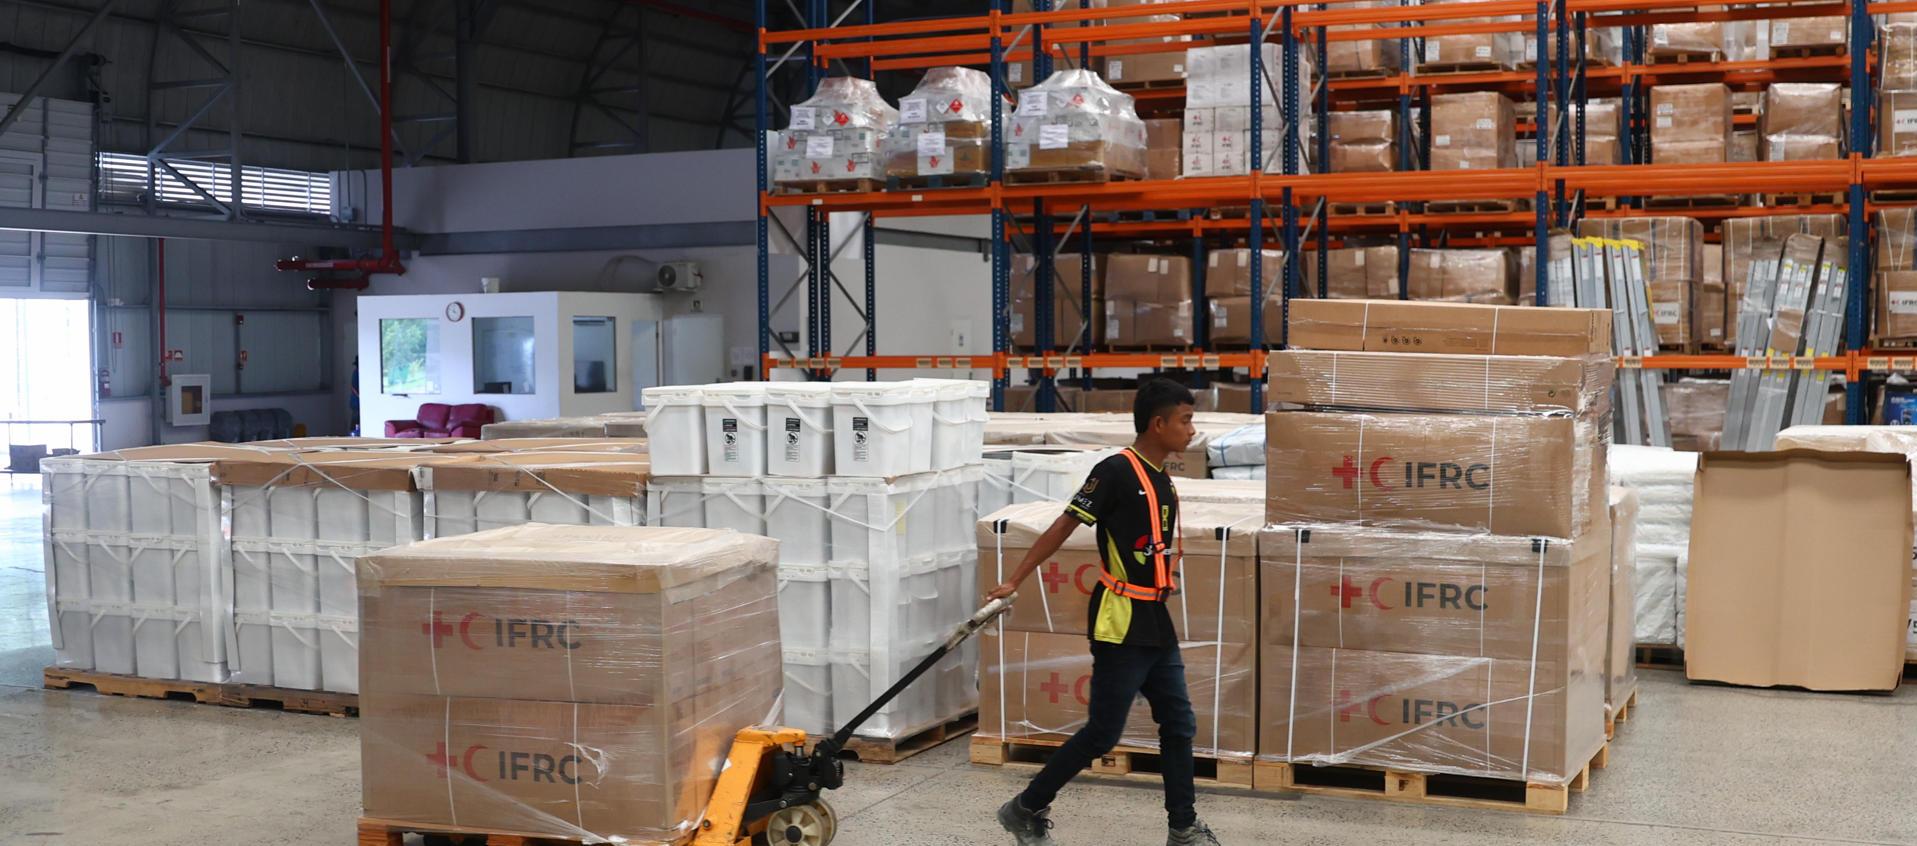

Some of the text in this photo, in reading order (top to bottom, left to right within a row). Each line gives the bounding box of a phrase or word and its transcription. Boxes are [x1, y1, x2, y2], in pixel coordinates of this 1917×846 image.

[1162, 461, 1185, 472] FRC
[1405, 461, 1490, 490] IFRC
[1404, 581, 1489, 611] IFRC
[495, 618, 582, 650] IFRC
[1402, 698, 1486, 729] IFRC
[498, 750, 584, 785] IFRC
